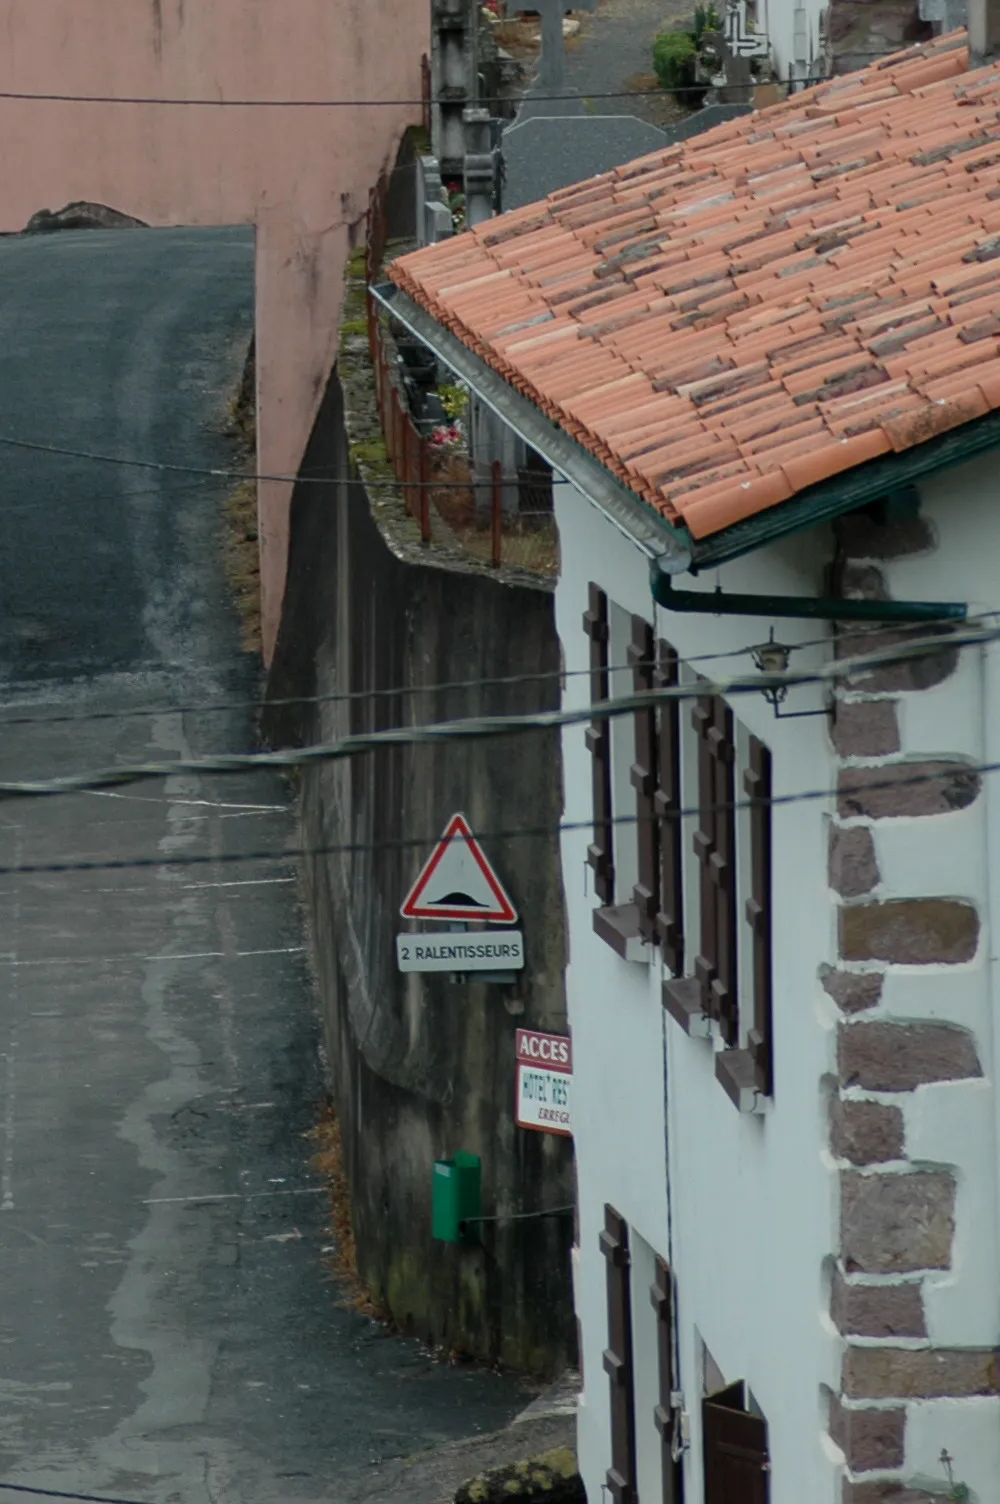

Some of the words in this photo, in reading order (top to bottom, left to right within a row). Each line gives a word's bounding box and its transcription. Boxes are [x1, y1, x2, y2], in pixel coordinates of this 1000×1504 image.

[400, 948, 410, 960] 2
[415, 944, 520, 959] RALENTISSEURS
[519, 1034, 569, 1062] ACCES
